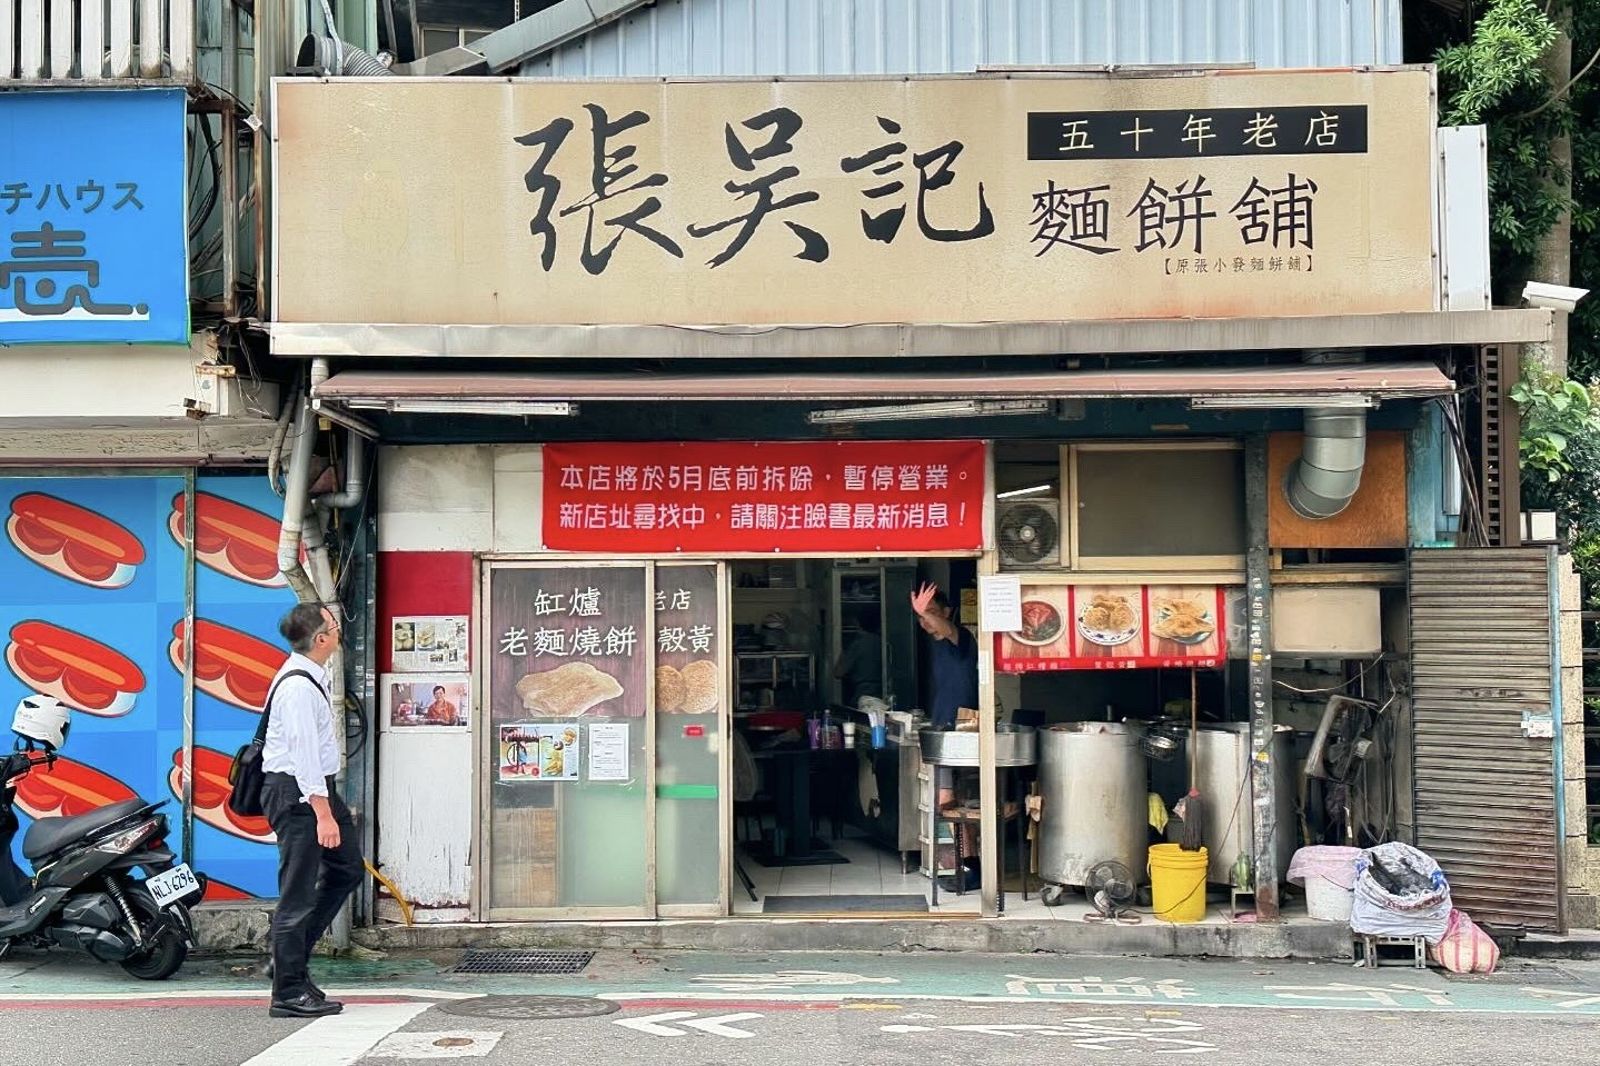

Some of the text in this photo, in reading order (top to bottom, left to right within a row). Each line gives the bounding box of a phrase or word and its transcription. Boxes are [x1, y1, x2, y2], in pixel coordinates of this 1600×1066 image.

[1059, 110, 1341, 153] 五十年老店
[0, 179, 145, 215] チハウス
[513, 103, 996, 275] 張吳記
[1028, 172, 1321, 258] 麵餅舖
[533, 586, 602, 617] 缸爐
[499, 625, 637, 658] 老麵燒餅
